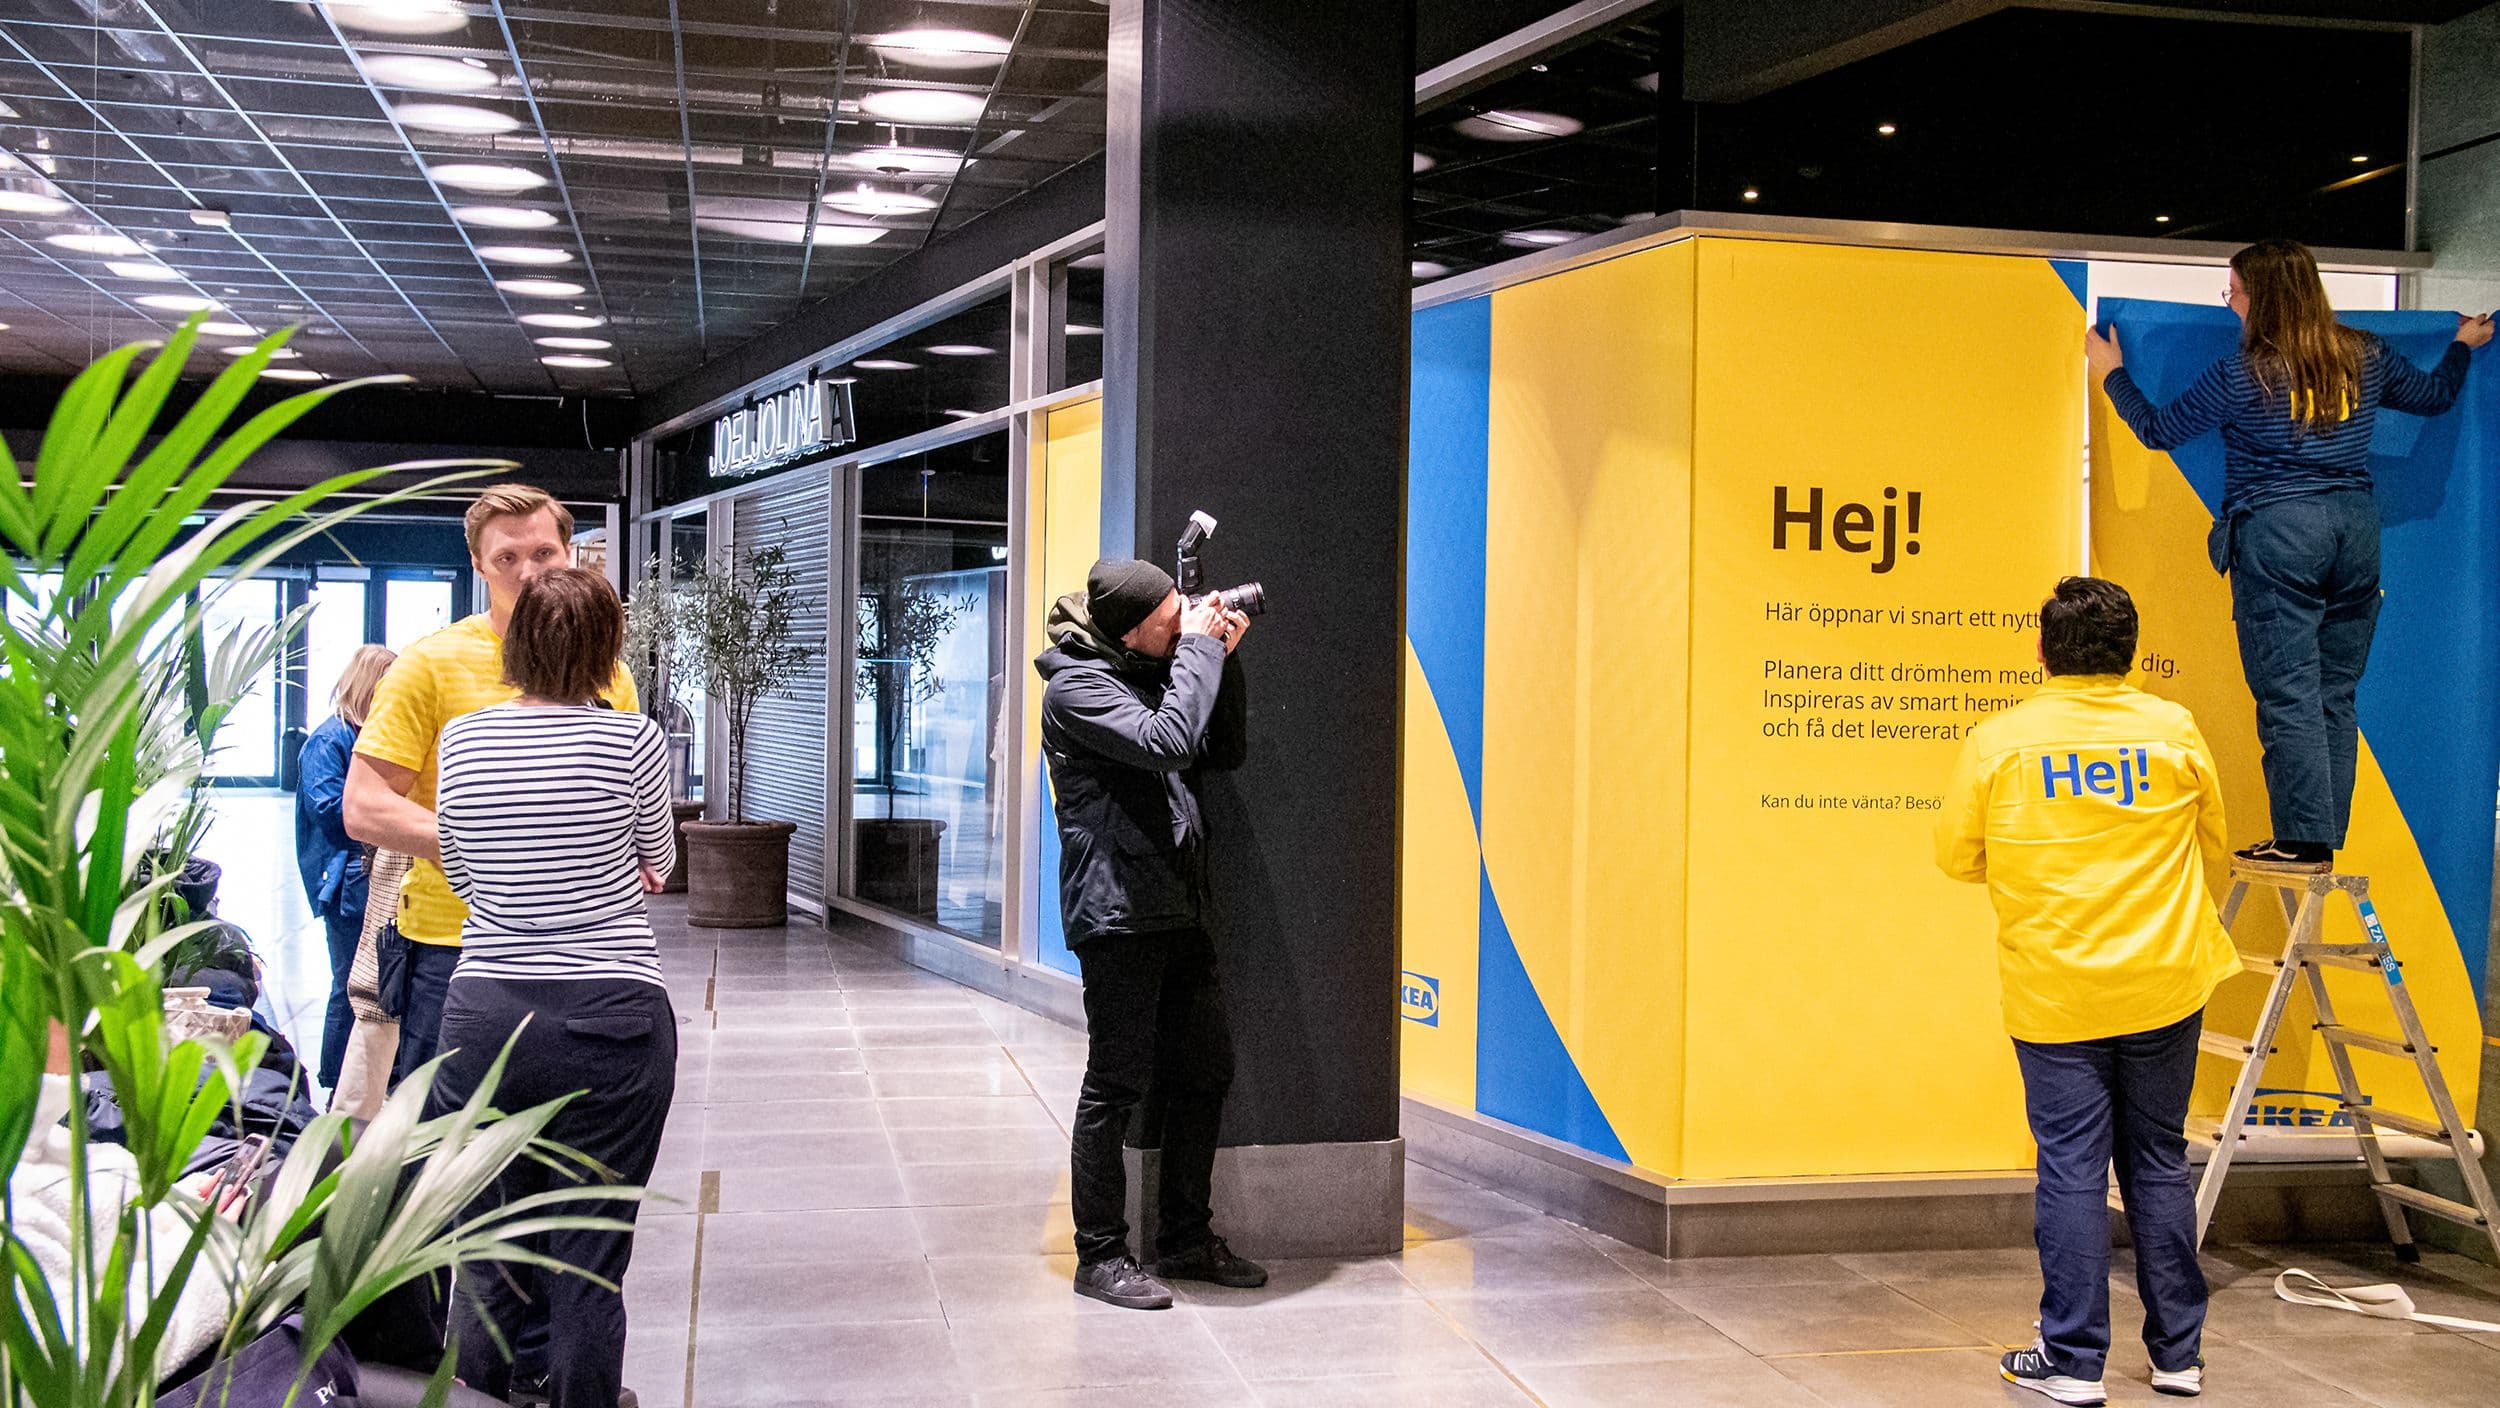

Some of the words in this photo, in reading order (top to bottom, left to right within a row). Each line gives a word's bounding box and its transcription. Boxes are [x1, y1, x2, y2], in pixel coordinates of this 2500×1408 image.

[1772, 486, 1922, 573] Hej!
[1766, 602, 1802, 621] Här
[1809, 603, 1883, 628] öppnar
[1889, 606, 1905, 625] vi
[1911, 609, 1963, 626] snart
[1969, 610, 1996, 627] ett
[2002, 611, 2041, 633] nytt
[1765, 659, 1842, 680] Planera
[1850, 661, 1884, 681] ditt
[1891, 662, 1992, 683] drömhem
[2000, 666, 2043, 685] med
[2141, 652, 2180, 678] dig.
[1764, 689, 1864, 713] Inspireras
[1871, 695, 1894, 710] av
[1900, 694, 1959, 711] smart
[1762, 718, 1799, 737] och
[1806, 717, 1825, 737] få
[1831, 719, 1864, 738] det
[1871, 720, 1959, 740] levererat
[2041, 747, 2150, 806] Hej!
[1761, 794, 1789, 808] Kan
[1795, 794, 1814, 808] du
[1819, 794, 1847, 809] inte
[1851, 795, 1901, 810] vänta?
[1906, 796, 1945, 810] Besö
[2370, 926, 2395, 972] ZAES
[2243, 1104, 2352, 1127] IKEA
